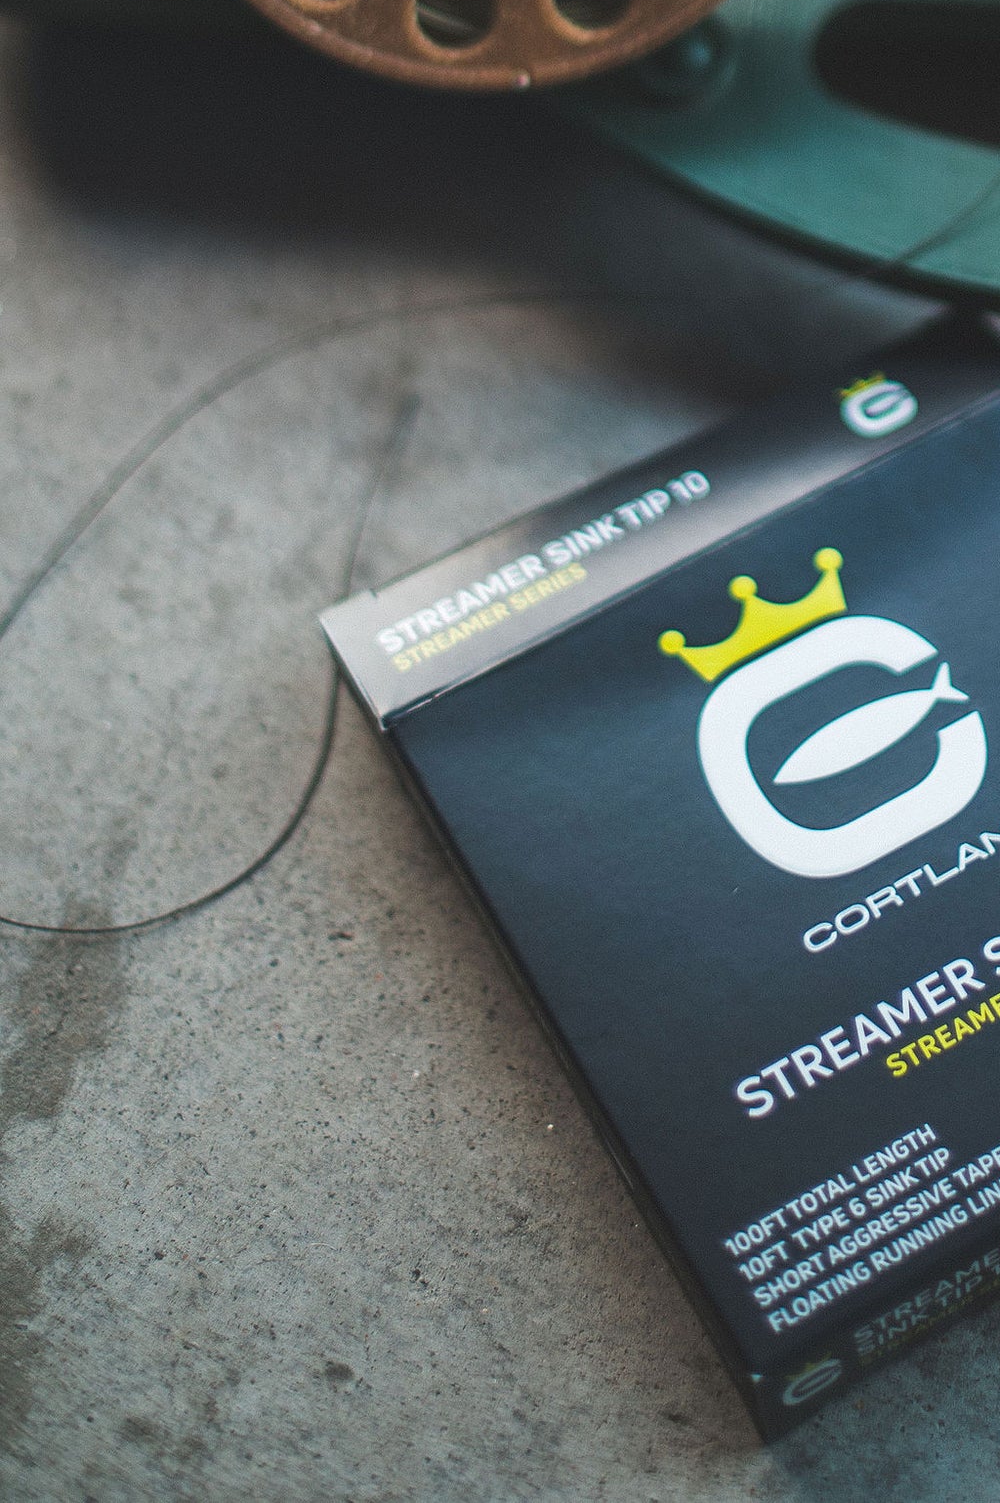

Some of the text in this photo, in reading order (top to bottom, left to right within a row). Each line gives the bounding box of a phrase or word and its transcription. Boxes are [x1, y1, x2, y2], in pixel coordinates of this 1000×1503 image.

[376, 470, 711, 654] STREAMER SINK TIP 10
[392, 561, 588, 673] STREAMER SERIES
[736, 957, 985, 1118] STREAMER
[723, 1122, 937, 1257] 100FT TOTAL LENGTH
[738, 1146, 951, 1282] 10FT TYPE 6 SINK TIP
[753, 1250, 825, 1307] SHORT
[826, 1177, 958, 1266] AGGRESSIVE
[767, 1261, 870, 1333] FLOATING
[870, 1204, 969, 1273] RUNNING
[934, 1275, 983, 1308] TIP
